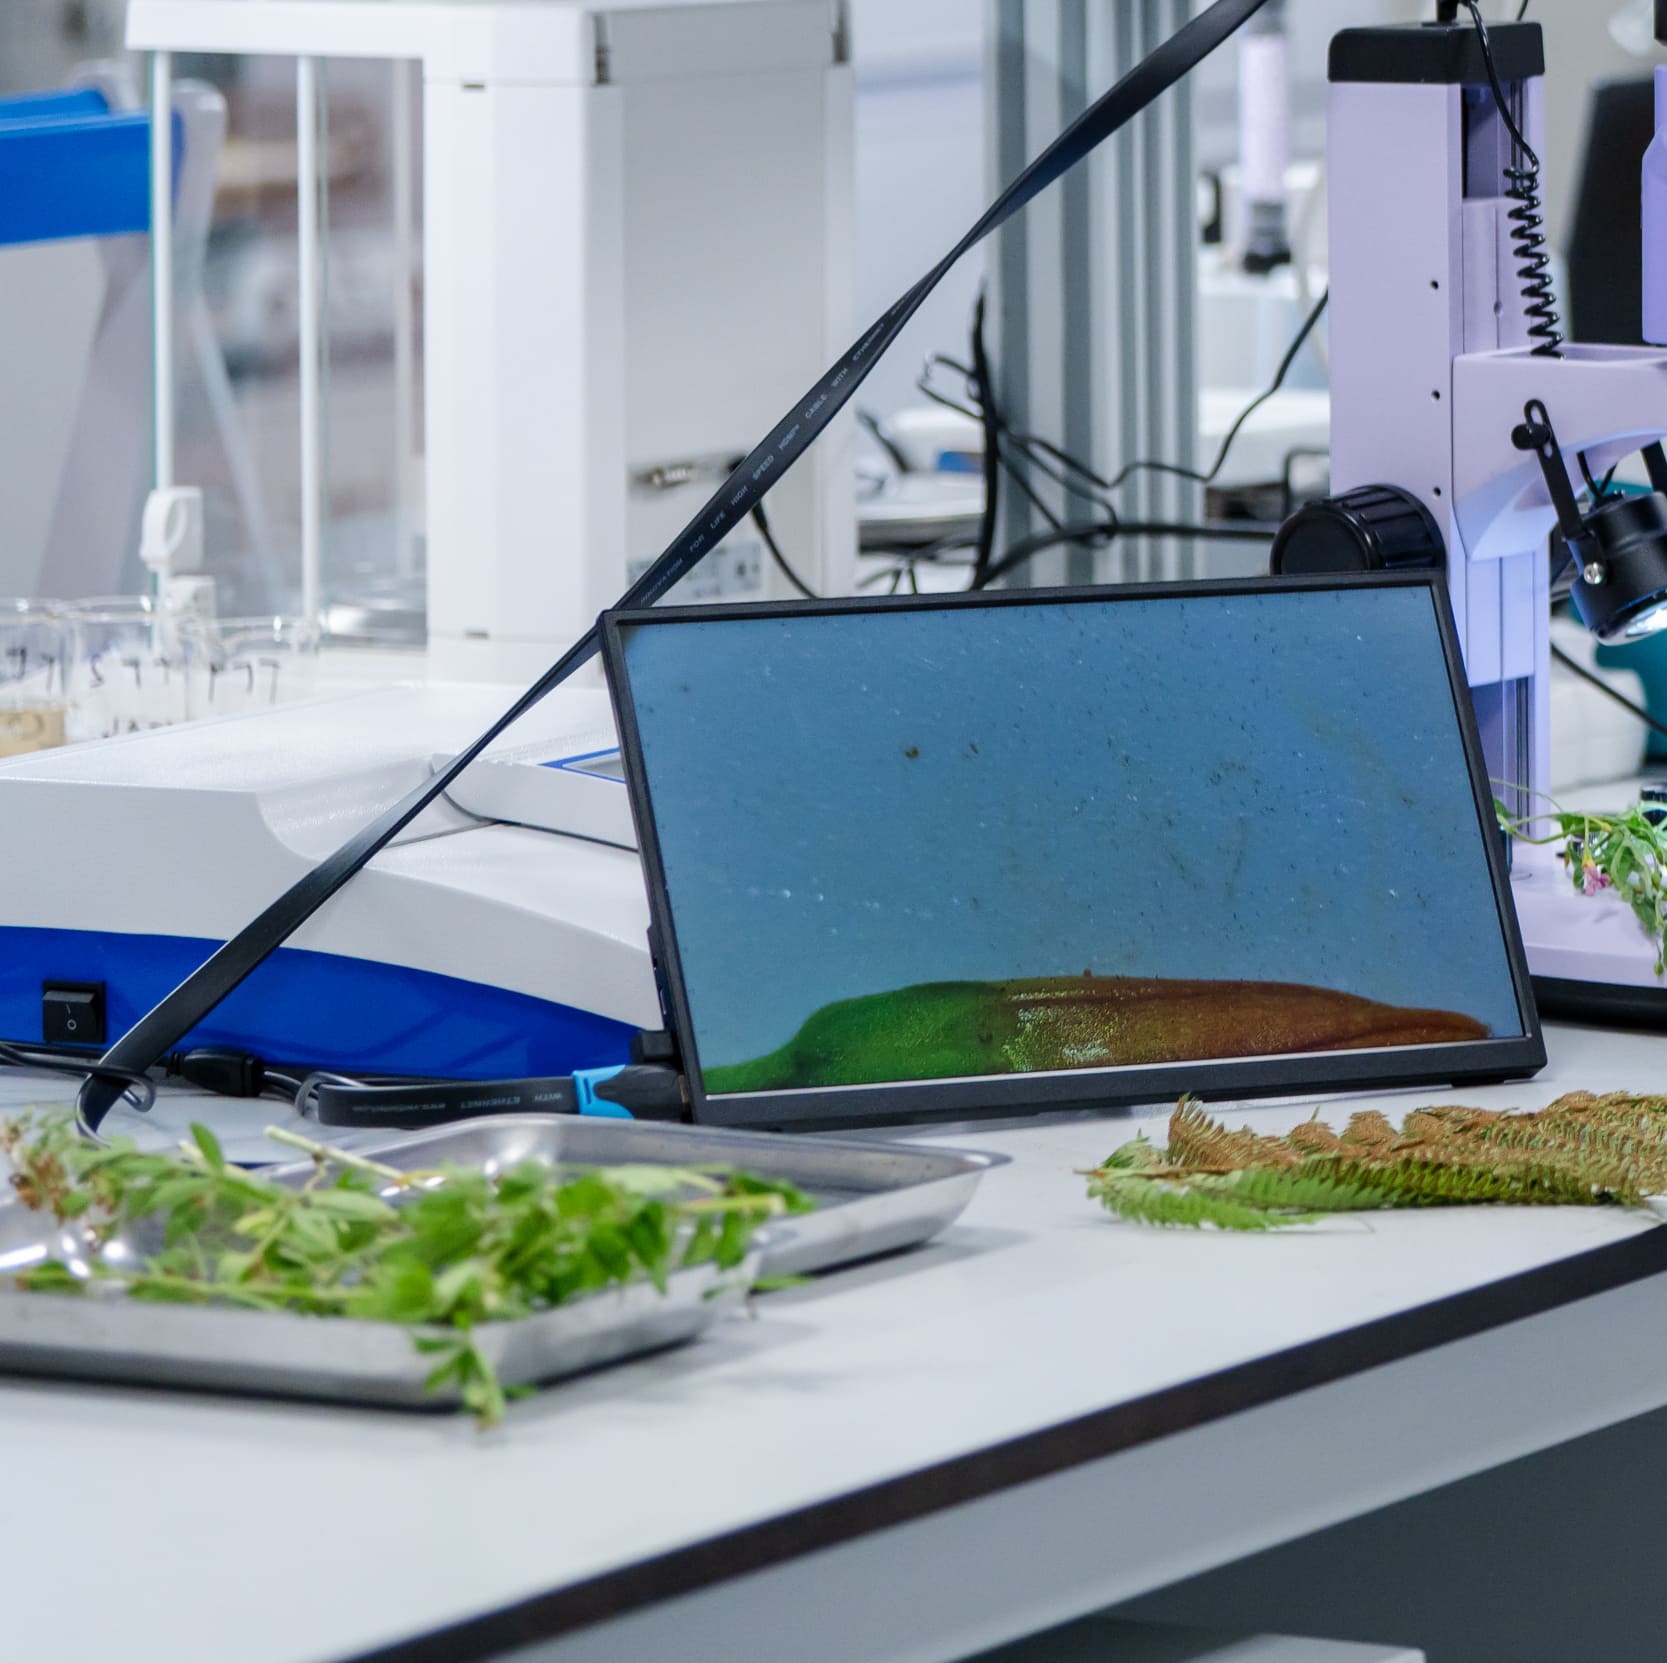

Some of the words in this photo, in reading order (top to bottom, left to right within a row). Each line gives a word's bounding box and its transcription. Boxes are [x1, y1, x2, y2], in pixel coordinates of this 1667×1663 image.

[710, 509, 727, 529] LIFE
[730, 485, 749, 506] HIGH
[752, 455, 775, 480] SPEED
